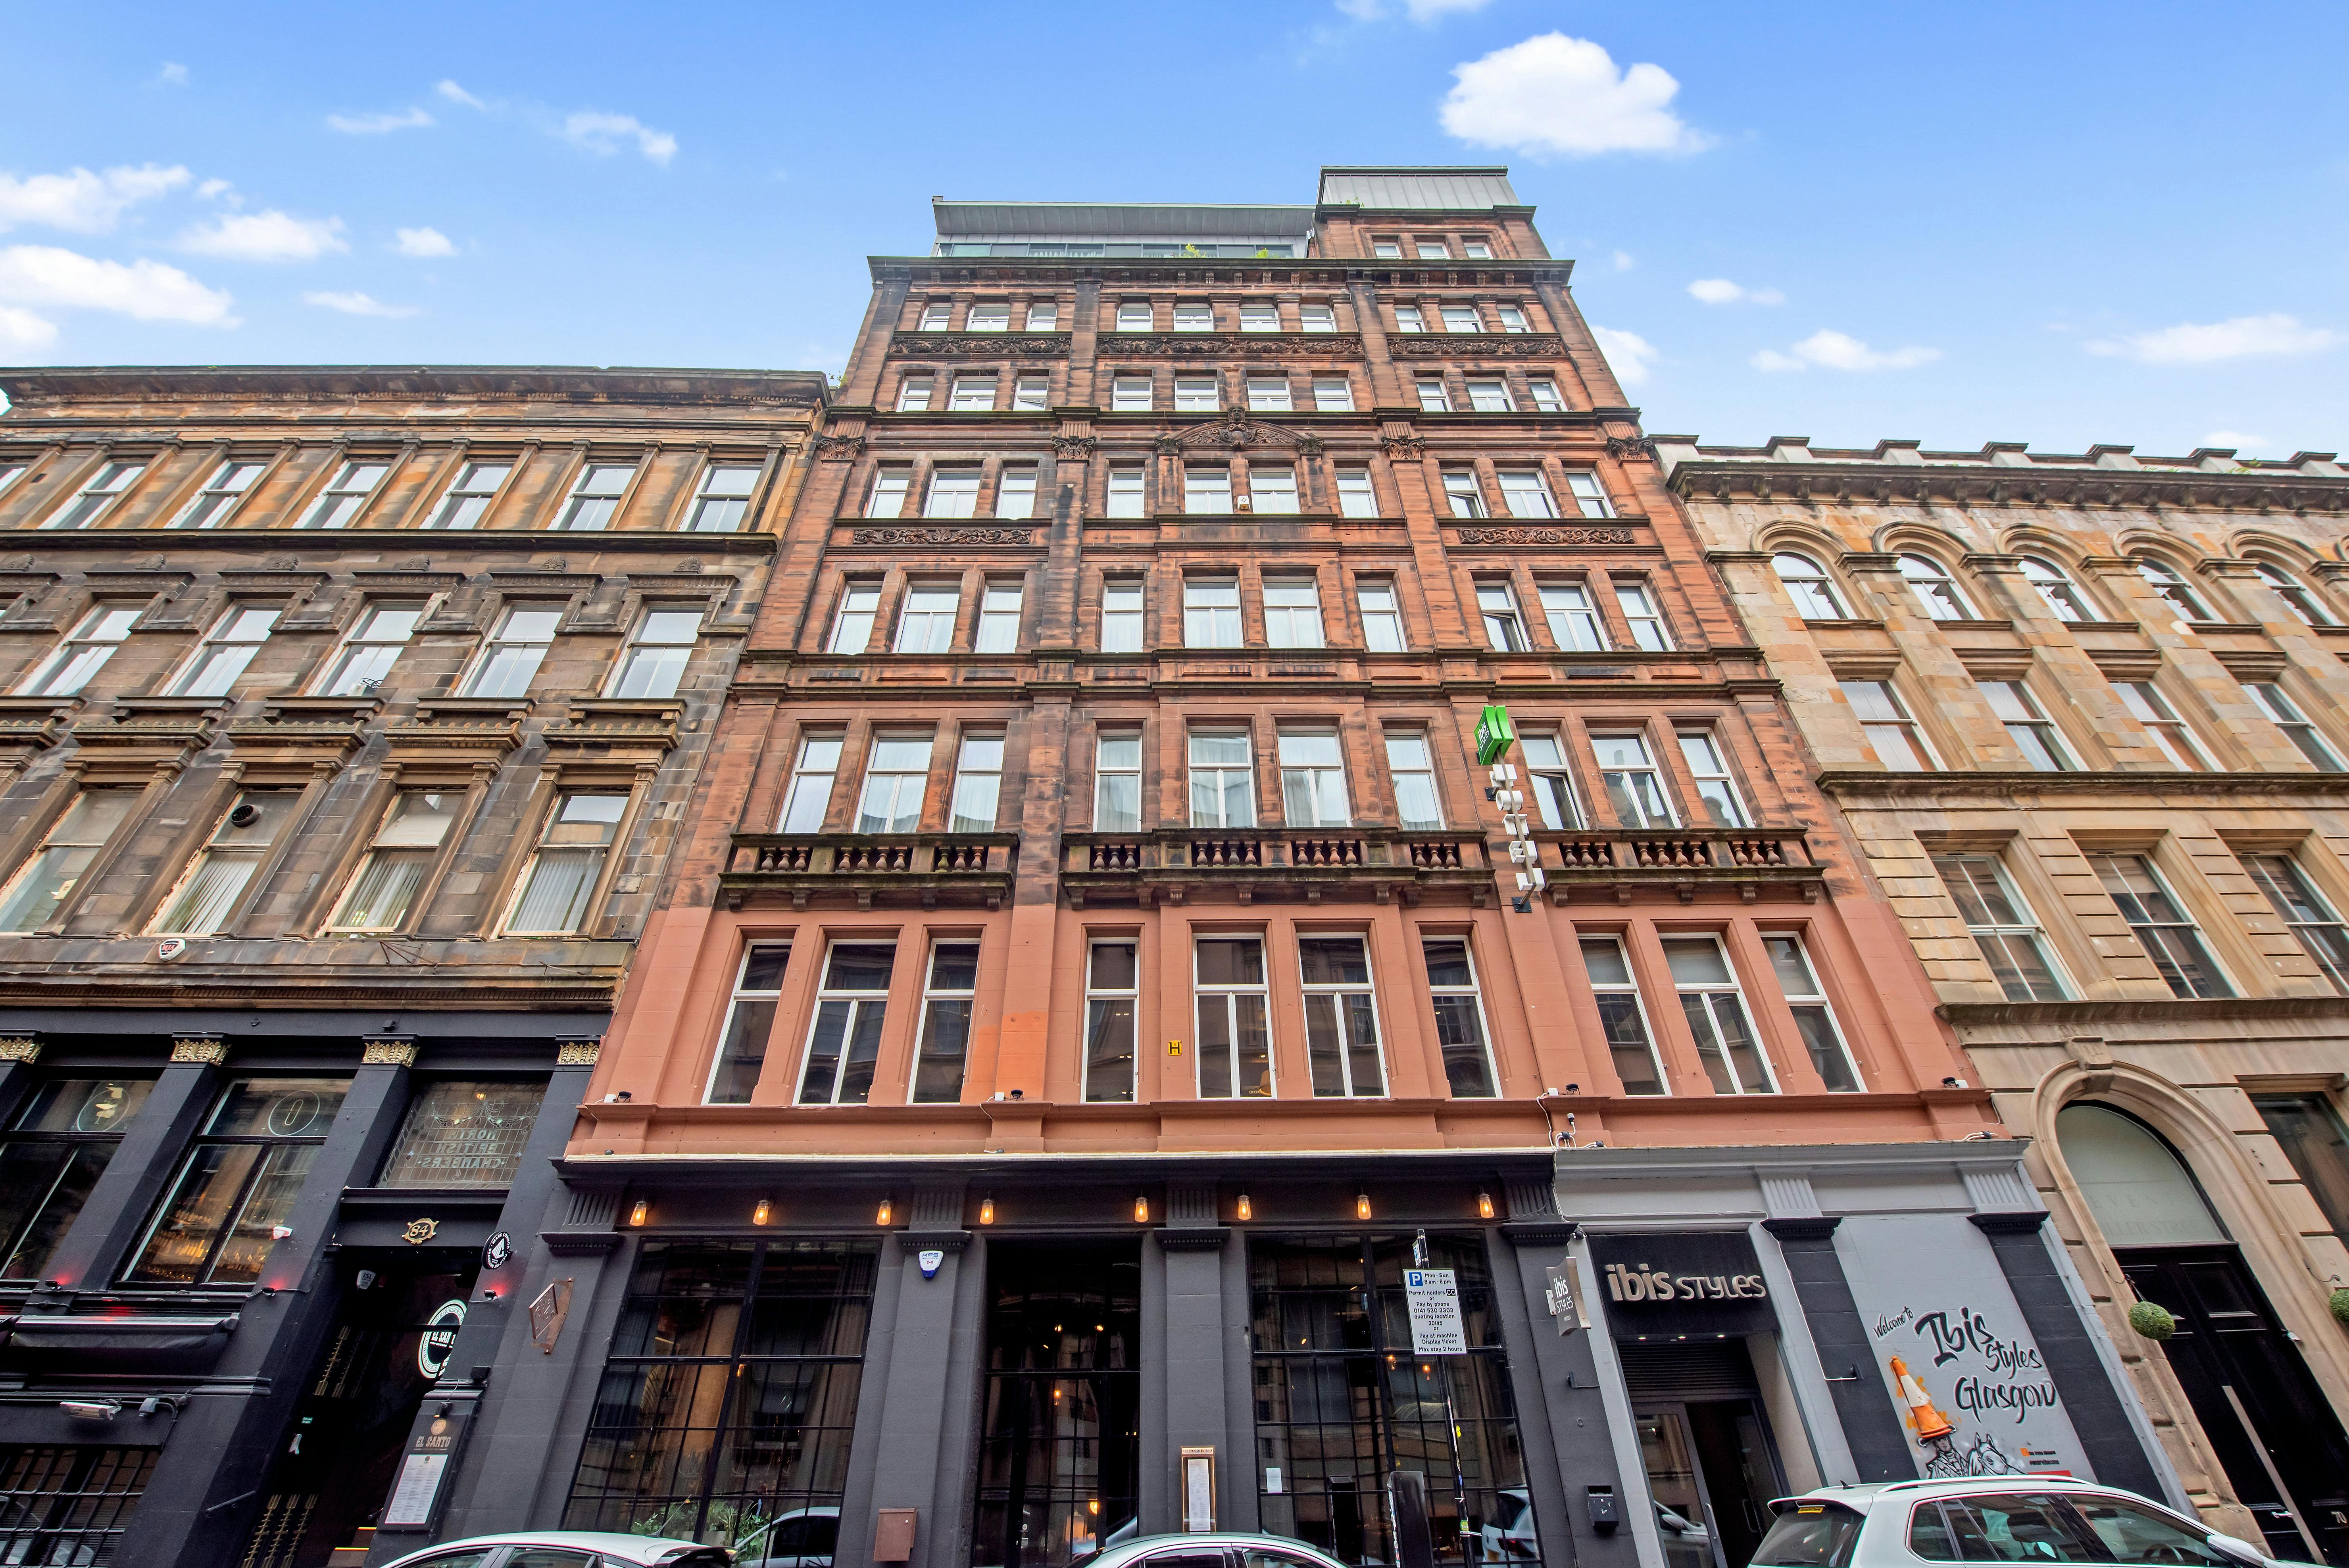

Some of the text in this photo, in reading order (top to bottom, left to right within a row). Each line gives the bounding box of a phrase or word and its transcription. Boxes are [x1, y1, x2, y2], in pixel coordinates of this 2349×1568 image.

[1478, 722, 1487, 742] ibis
[1170, 1042, 1180, 1054] H
[409, 1225, 429, 1237] 84
[2101, 1220, 2148, 1236] ILLER
[492, 1233, 502, 1245] MARK
[494, 1253, 507, 1268] JIU-JITSU
[1412, 1273, 1421, 1285] P
[1553, 1275, 1569, 1299] ibis
[1605, 1263, 1675, 1302] ibis
[1873, 1306, 1914, 1339] Welcome to
[1915, 1307, 1997, 1367] Ibis
[1985, 1340, 2043, 1380] Styles
[1955, 1376, 2056, 1426] Glasgow
[415, 1436, 451, 1447] EL SANTO
[2330, 1510, 2347, 1524] 70
